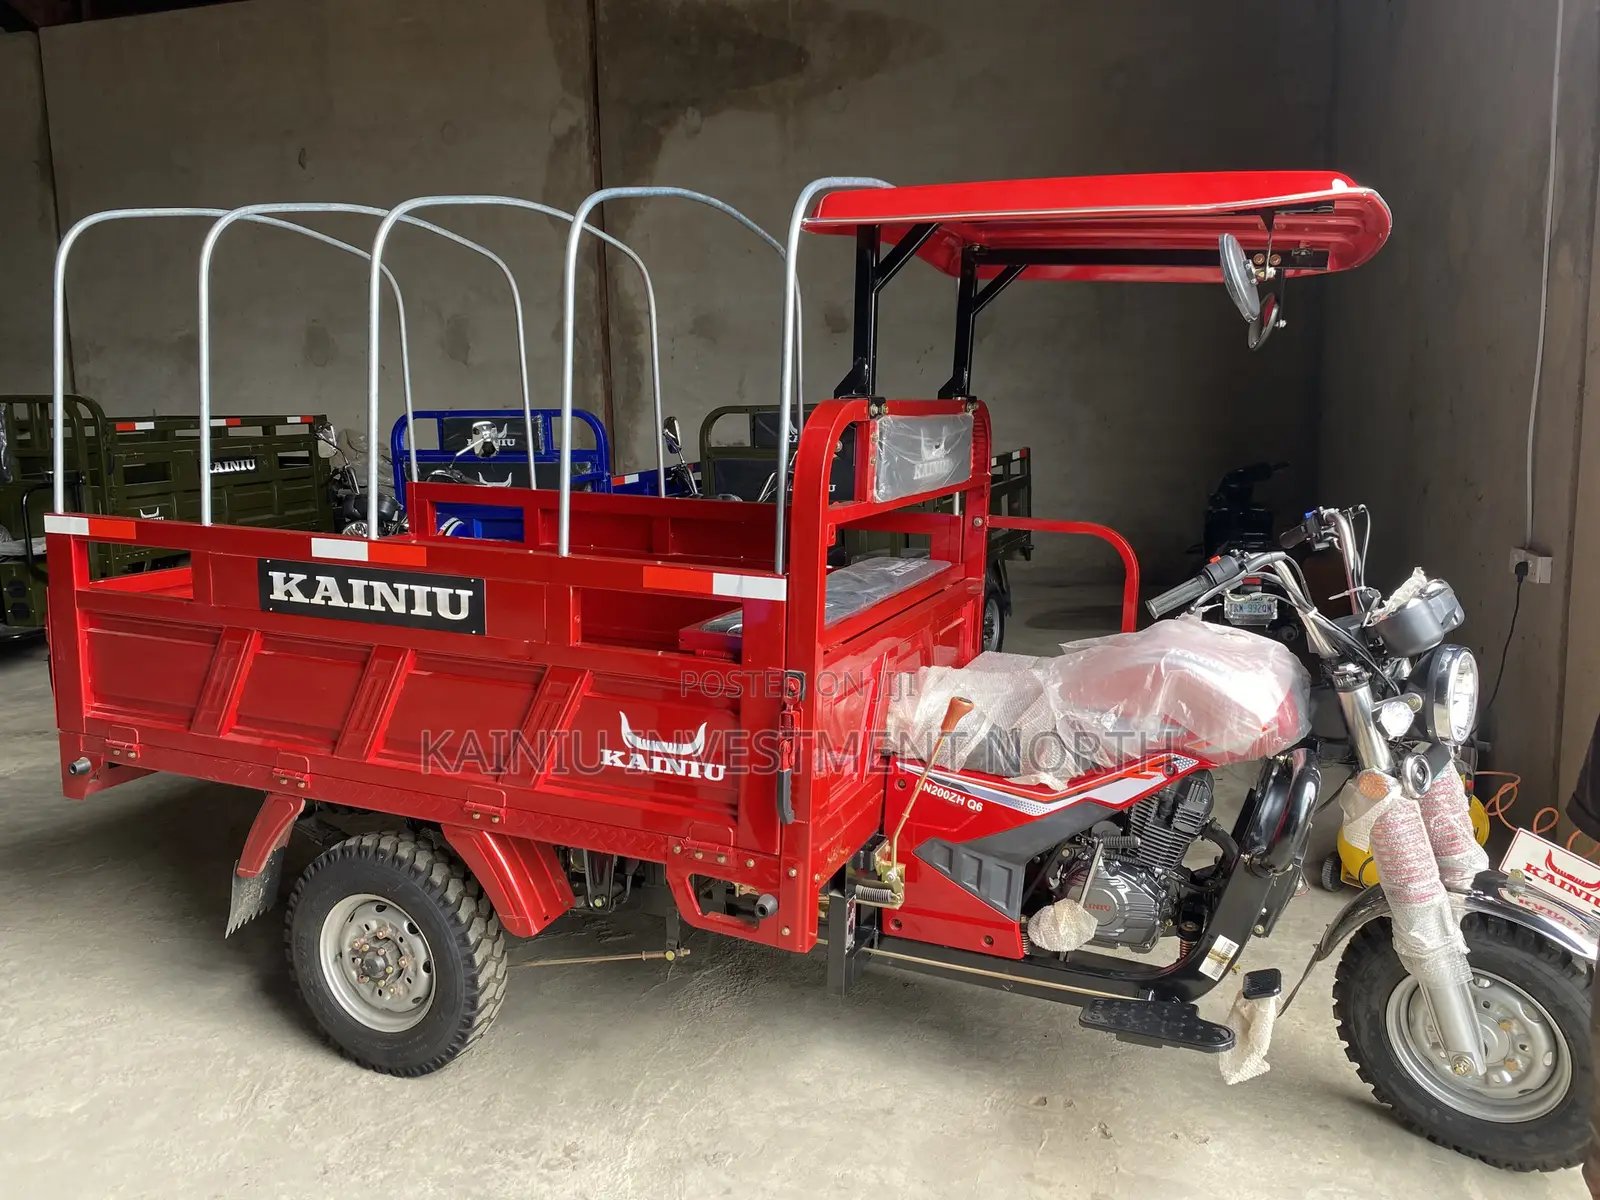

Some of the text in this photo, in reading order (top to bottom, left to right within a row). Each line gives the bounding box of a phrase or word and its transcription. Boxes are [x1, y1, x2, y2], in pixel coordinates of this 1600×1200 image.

[268, 571, 474, 621] KAINIU
[600, 748, 726, 781] KAINIU
[967, 799, 984, 812] Q6
